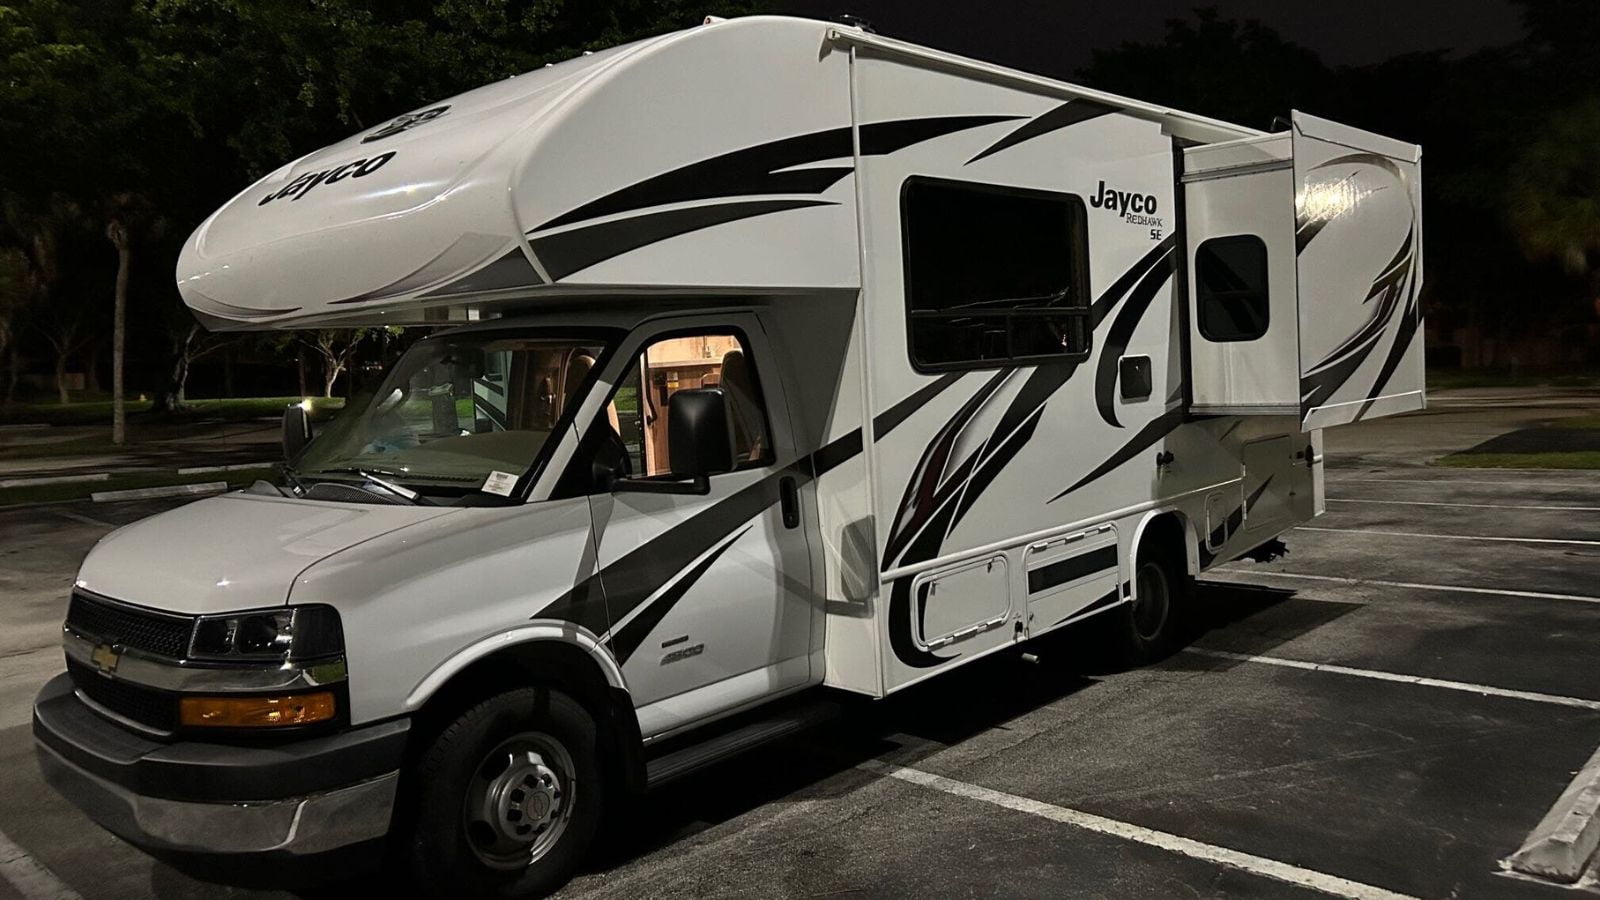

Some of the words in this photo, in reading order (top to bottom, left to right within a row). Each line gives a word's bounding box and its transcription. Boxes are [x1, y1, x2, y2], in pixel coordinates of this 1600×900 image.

[258, 150, 397, 206] Jayco
[1090, 180, 1157, 217] Jayco
[1126, 212, 1163, 227] REDHAWK
[1150, 229, 1162, 240] SE
